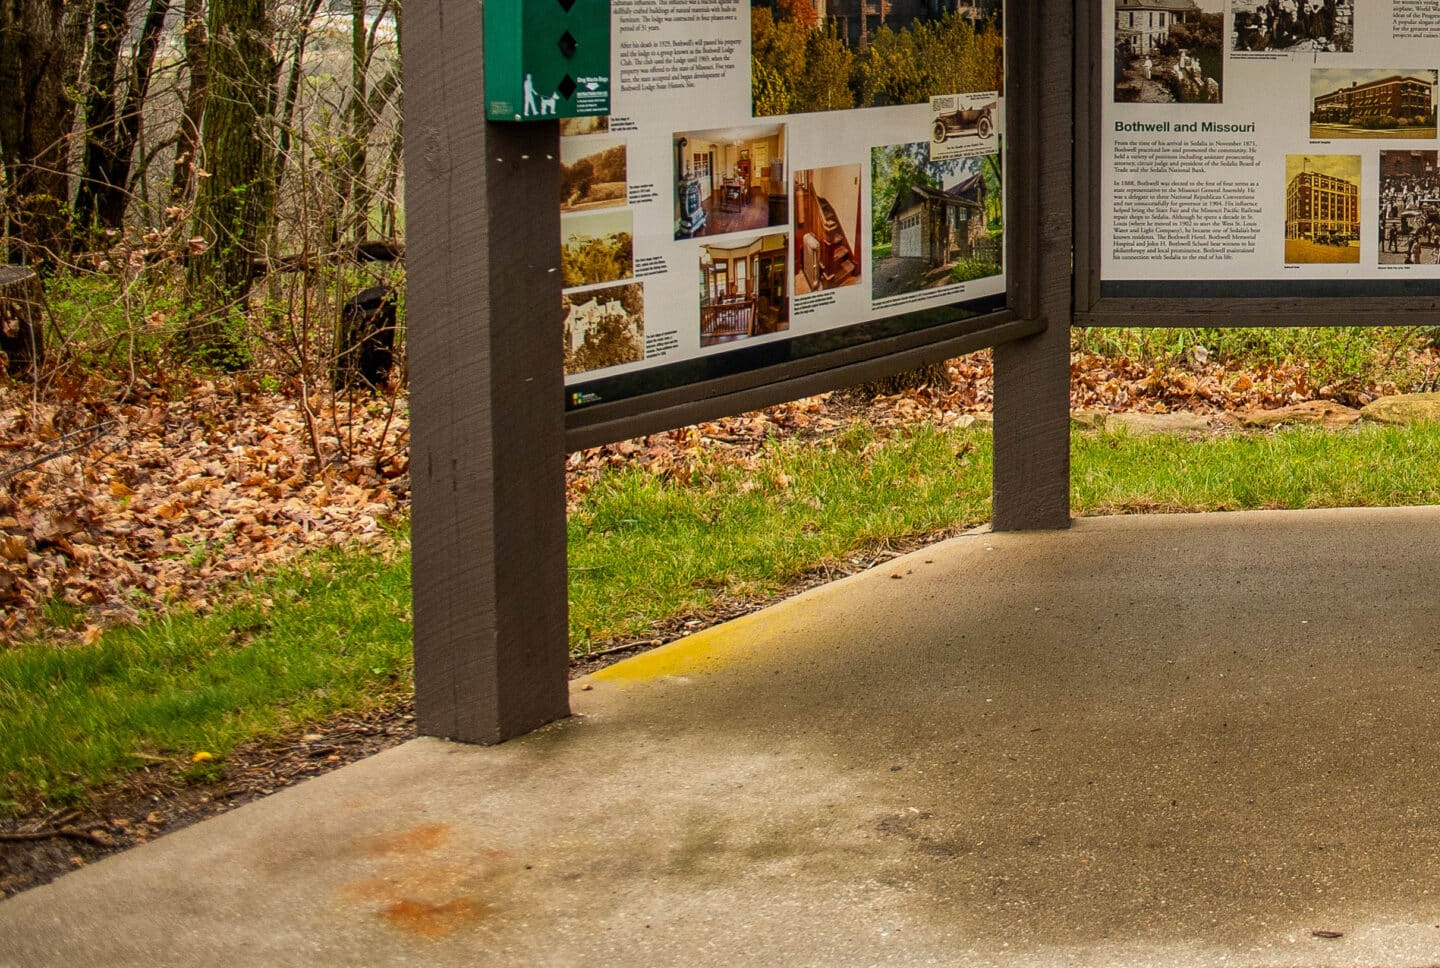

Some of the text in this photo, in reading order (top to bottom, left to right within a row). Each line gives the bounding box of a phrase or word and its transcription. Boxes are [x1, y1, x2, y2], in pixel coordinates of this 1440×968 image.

[1115, 121, 1255, 132] Bothwell and Missouri
